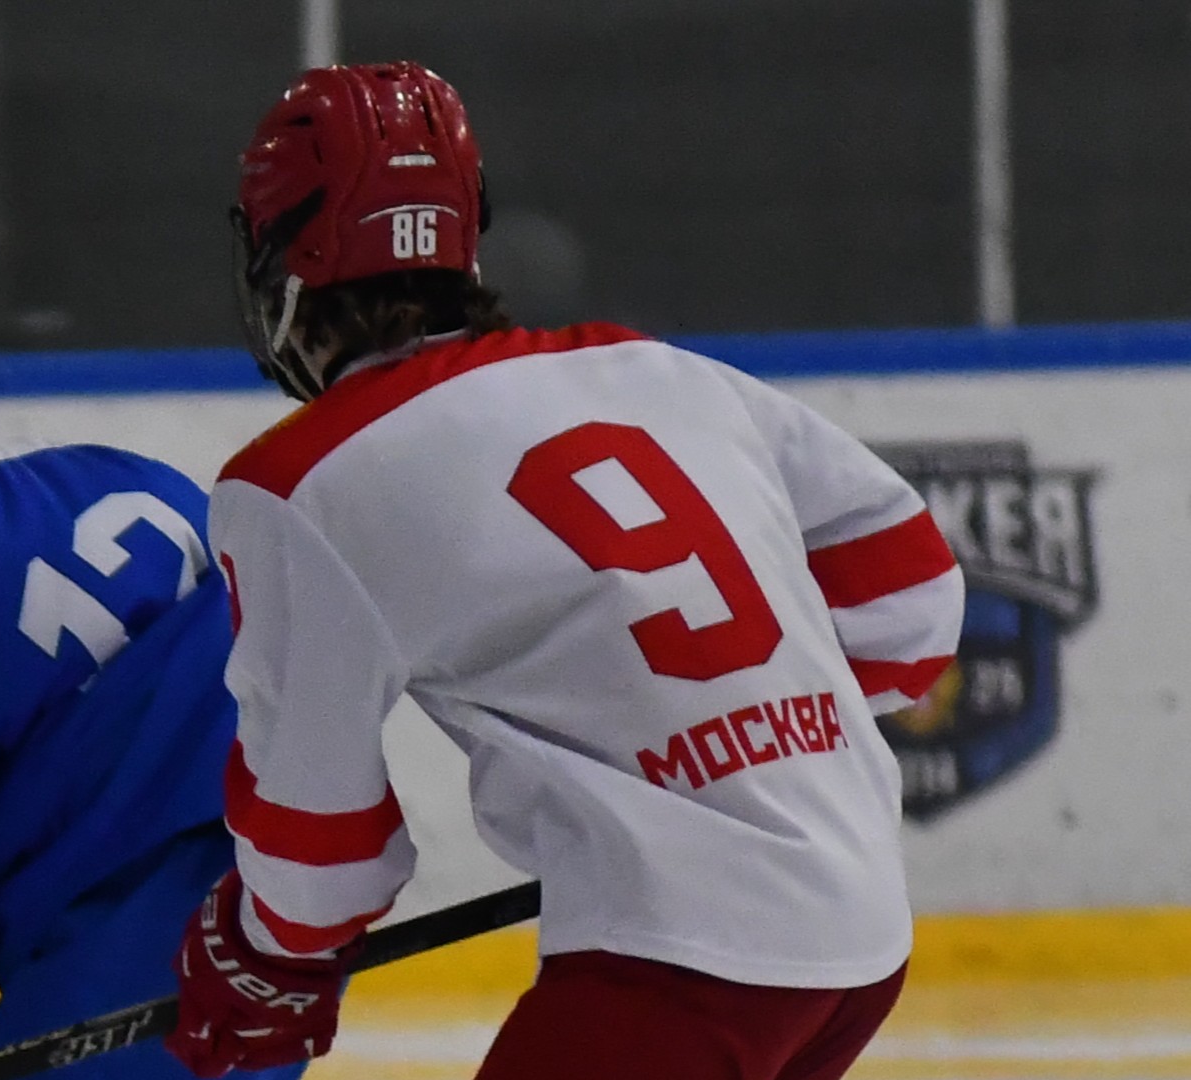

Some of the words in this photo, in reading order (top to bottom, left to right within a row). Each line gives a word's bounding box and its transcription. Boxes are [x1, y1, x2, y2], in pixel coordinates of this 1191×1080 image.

[392, 210, 437, 259] 86
[18, 491, 209, 691] 12
[506, 421, 784, 681] 9
[636, 692, 848, 789] МОСКВА
[201, 879, 319, 1015] AUER
